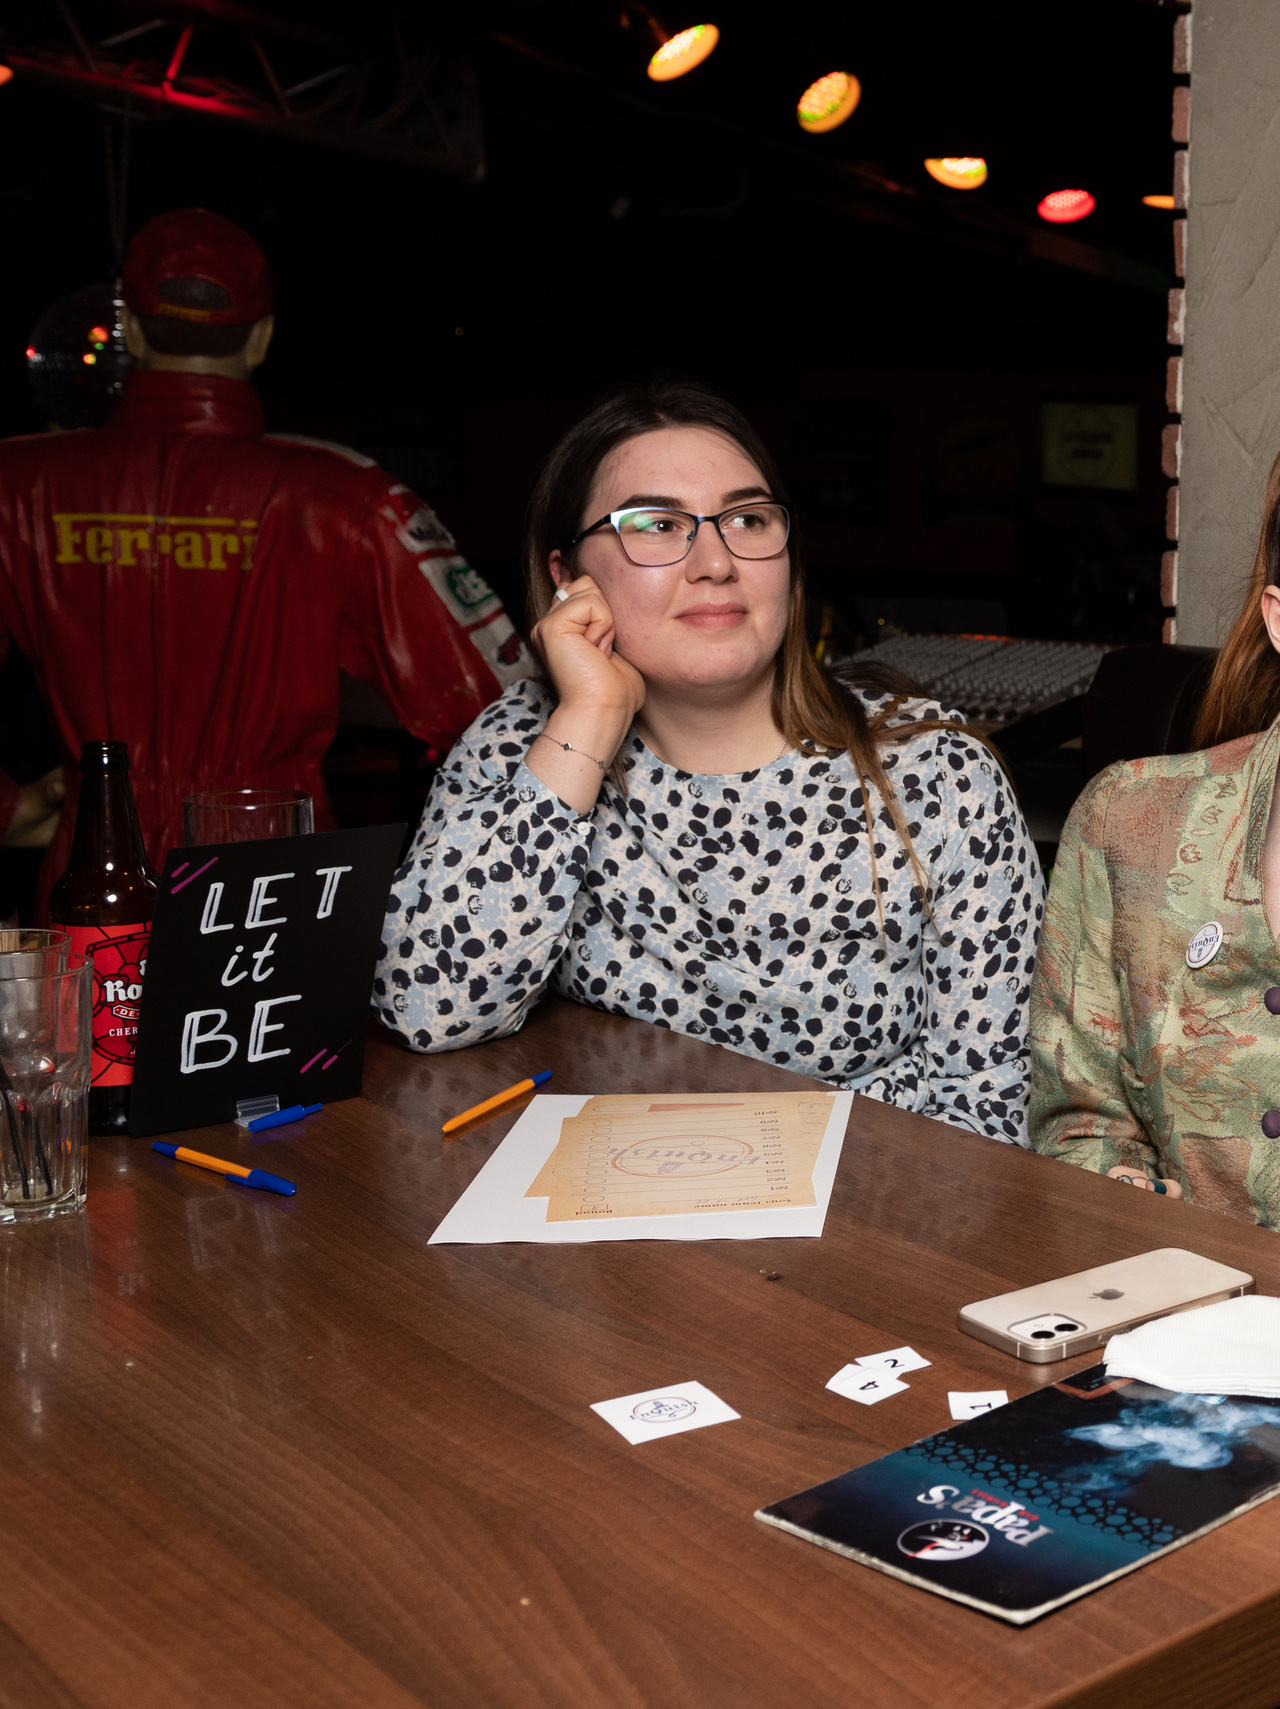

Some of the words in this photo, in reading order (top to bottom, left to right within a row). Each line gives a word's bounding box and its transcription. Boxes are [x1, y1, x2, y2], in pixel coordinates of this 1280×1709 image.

[200, 865, 353, 935] LET
[221, 933, 277, 986] it
[103, 979, 143, 1003] Ro
[109, 1027, 138, 1037] CHER
[180, 995, 302, 1074] BE
[884, 1358, 905, 1369] 2
[858, 1380, 880, 1391] 4
[968, 1402, 993, 1410] 1
[916, 1484, 1055, 1548] Papa's
